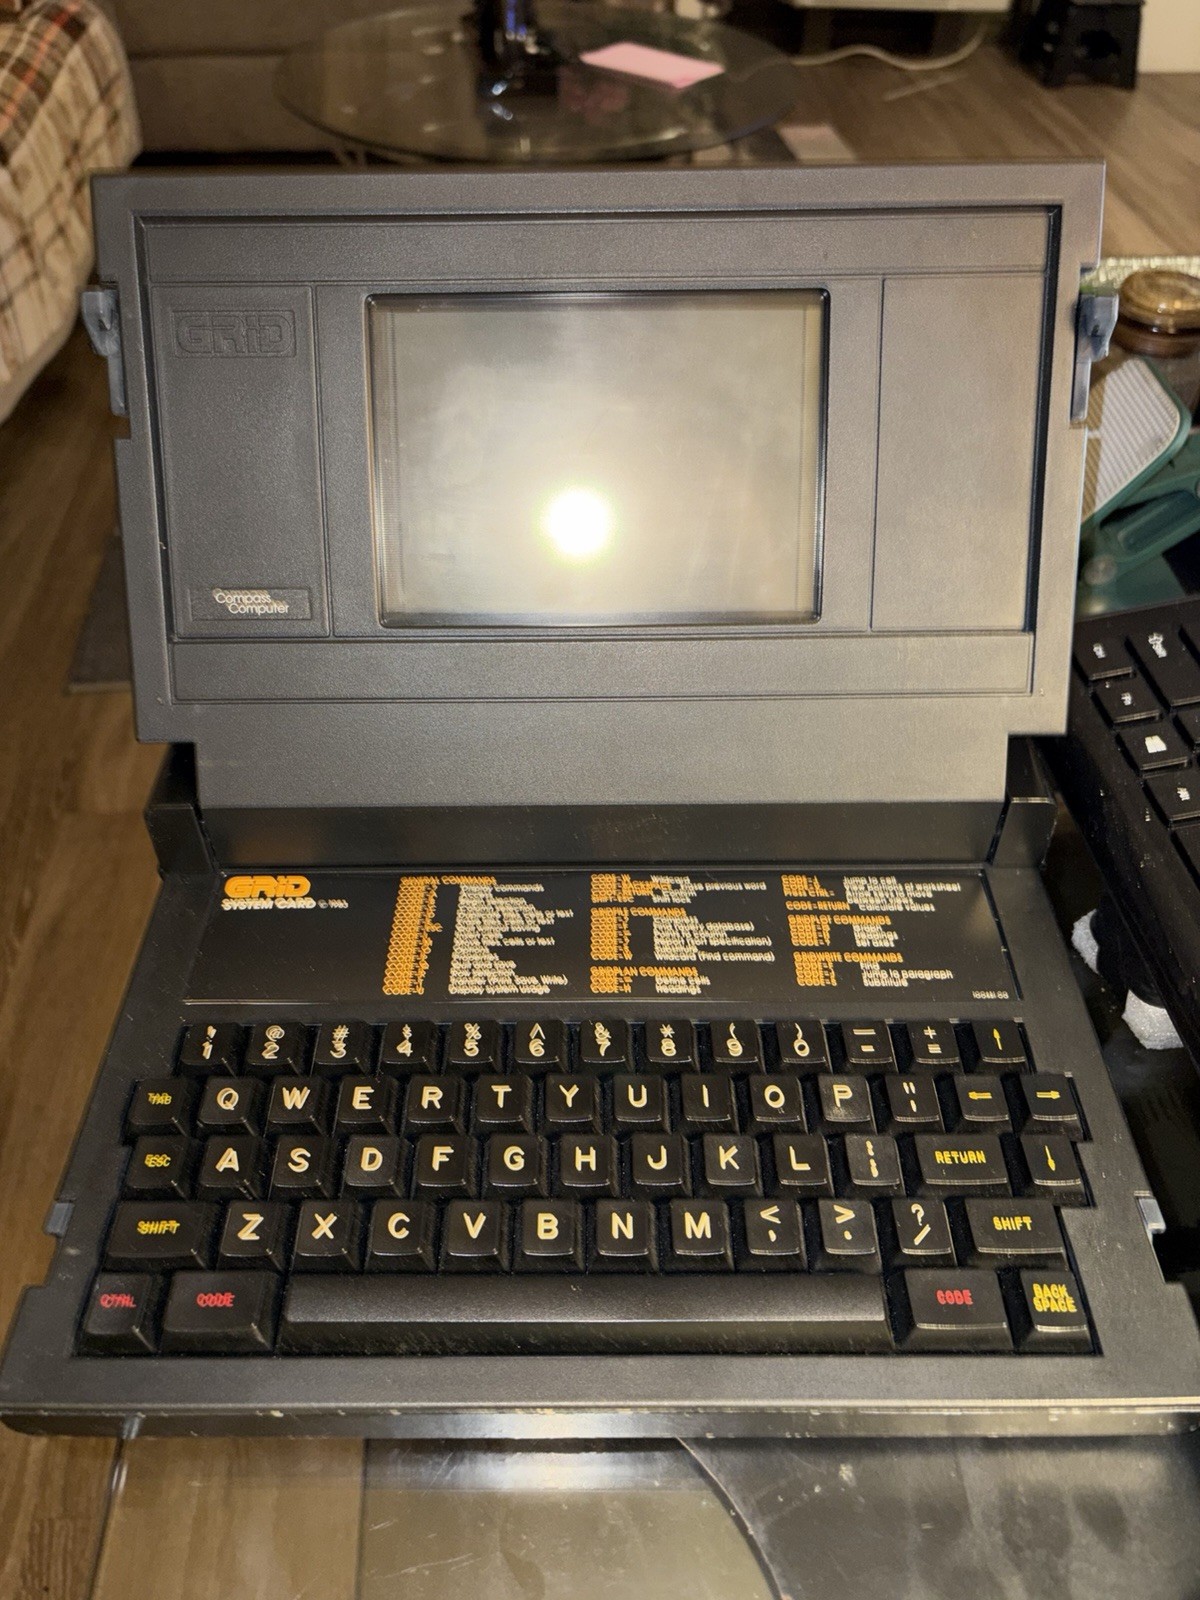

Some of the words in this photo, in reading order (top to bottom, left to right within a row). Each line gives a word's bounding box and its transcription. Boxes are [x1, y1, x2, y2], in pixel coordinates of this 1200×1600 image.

[213, 588, 272, 605] Compass
[227, 599, 290, 616] Computer
[221, 898, 274, 911] SYSTEM
[274, 897, 316, 910] CARD
[265, 1024, 286, 1042] @
[331, 1024, 349, 1042] #
[463, 1022, 482, 1041] %
[923, 1025, 937, 1040] +
[202, 1041, 213, 1060] 1
[262, 1042, 280, 1059] 2
[330, 1042, 347, 1059] 3
[397, 1040, 414, 1057] 4
[463, 1039, 479, 1057] 5
[529, 1038, 546, 1057] 6
[597, 1038, 612, 1057] 7
[660, 1037, 677, 1057] 8
[727, 1036, 744, 1057] 9
[792, 1039, 810, 1058] 0
[147, 1092, 172, 1105] TAB
[217, 1088, 239, 1111] Q
[282, 1087, 311, 1110] W
[352, 1085, 374, 1110] E
[420, 1086, 443, 1109] R
[491, 1084, 512, 1108] T
[559, 1084, 580, 1108] Y
[627, 1084, 648, 1108] U
[702, 1084, 710, 1108] I
[763, 1084, 785, 1109] O
[832, 1083, 853, 1107] P
[144, 1153, 171, 1168] ESC
[216, 1147, 240, 1172] A
[287, 1147, 311, 1173] S
[360, 1146, 383, 1172] D
[431, 1145, 454, 1172] F
[503, 1145, 525, 1171] G
[575, 1146, 596, 1171] H
[646, 1145, 668, 1170] J
[719, 1145, 740, 1170] K
[788, 1145, 811, 1171] L
[934, 1149, 987, 1165] RETURN
[683, 1211, 712, 1239] M
[910, 1203, 925, 1225] ?
[992, 1215, 1033, 1232] SHIFT
[136, 1219, 180, 1235] SHIFT
[237, 1213, 264, 1241] Z
[312, 1213, 338, 1240] X
[387, 1212, 410, 1239] C
[463, 1212, 487, 1239] V
[536, 1213, 559, 1240] B
[610, 1211, 634, 1240] N
[913, 1223, 932, 1246] /
[99, 1292, 136, 1309] CTRL
[195, 1291, 235, 1307] CODE
[935, 1288, 974, 1306] CODE
[1032, 1282, 1070, 1299] BACK
[1032, 1297, 1078, 1314] SPACE
